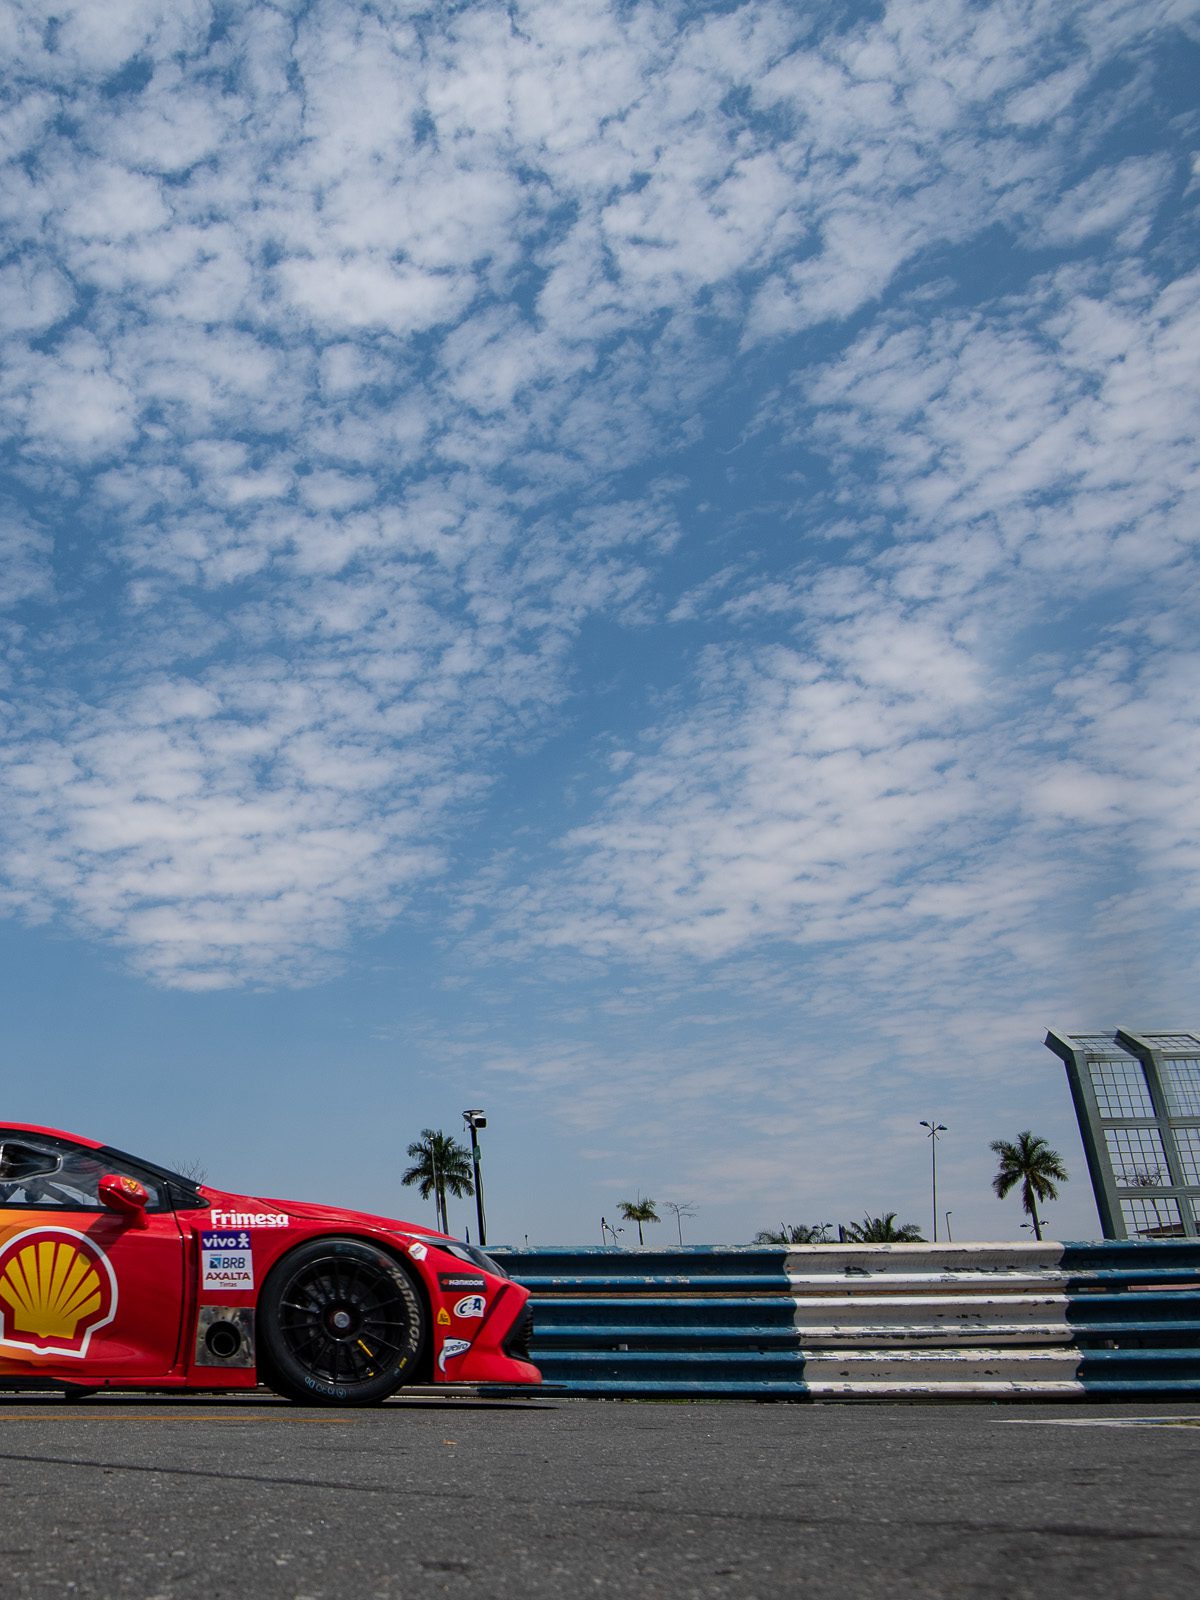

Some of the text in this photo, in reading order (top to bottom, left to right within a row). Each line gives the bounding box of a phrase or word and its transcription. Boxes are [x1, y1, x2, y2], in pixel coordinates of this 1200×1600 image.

[210, 1209, 289, 1228] Frimesa
[203, 1234, 237, 1248] vivo
[222, 1257, 246, 1269] BRB
[205, 1272, 251, 1281] AXALTA
